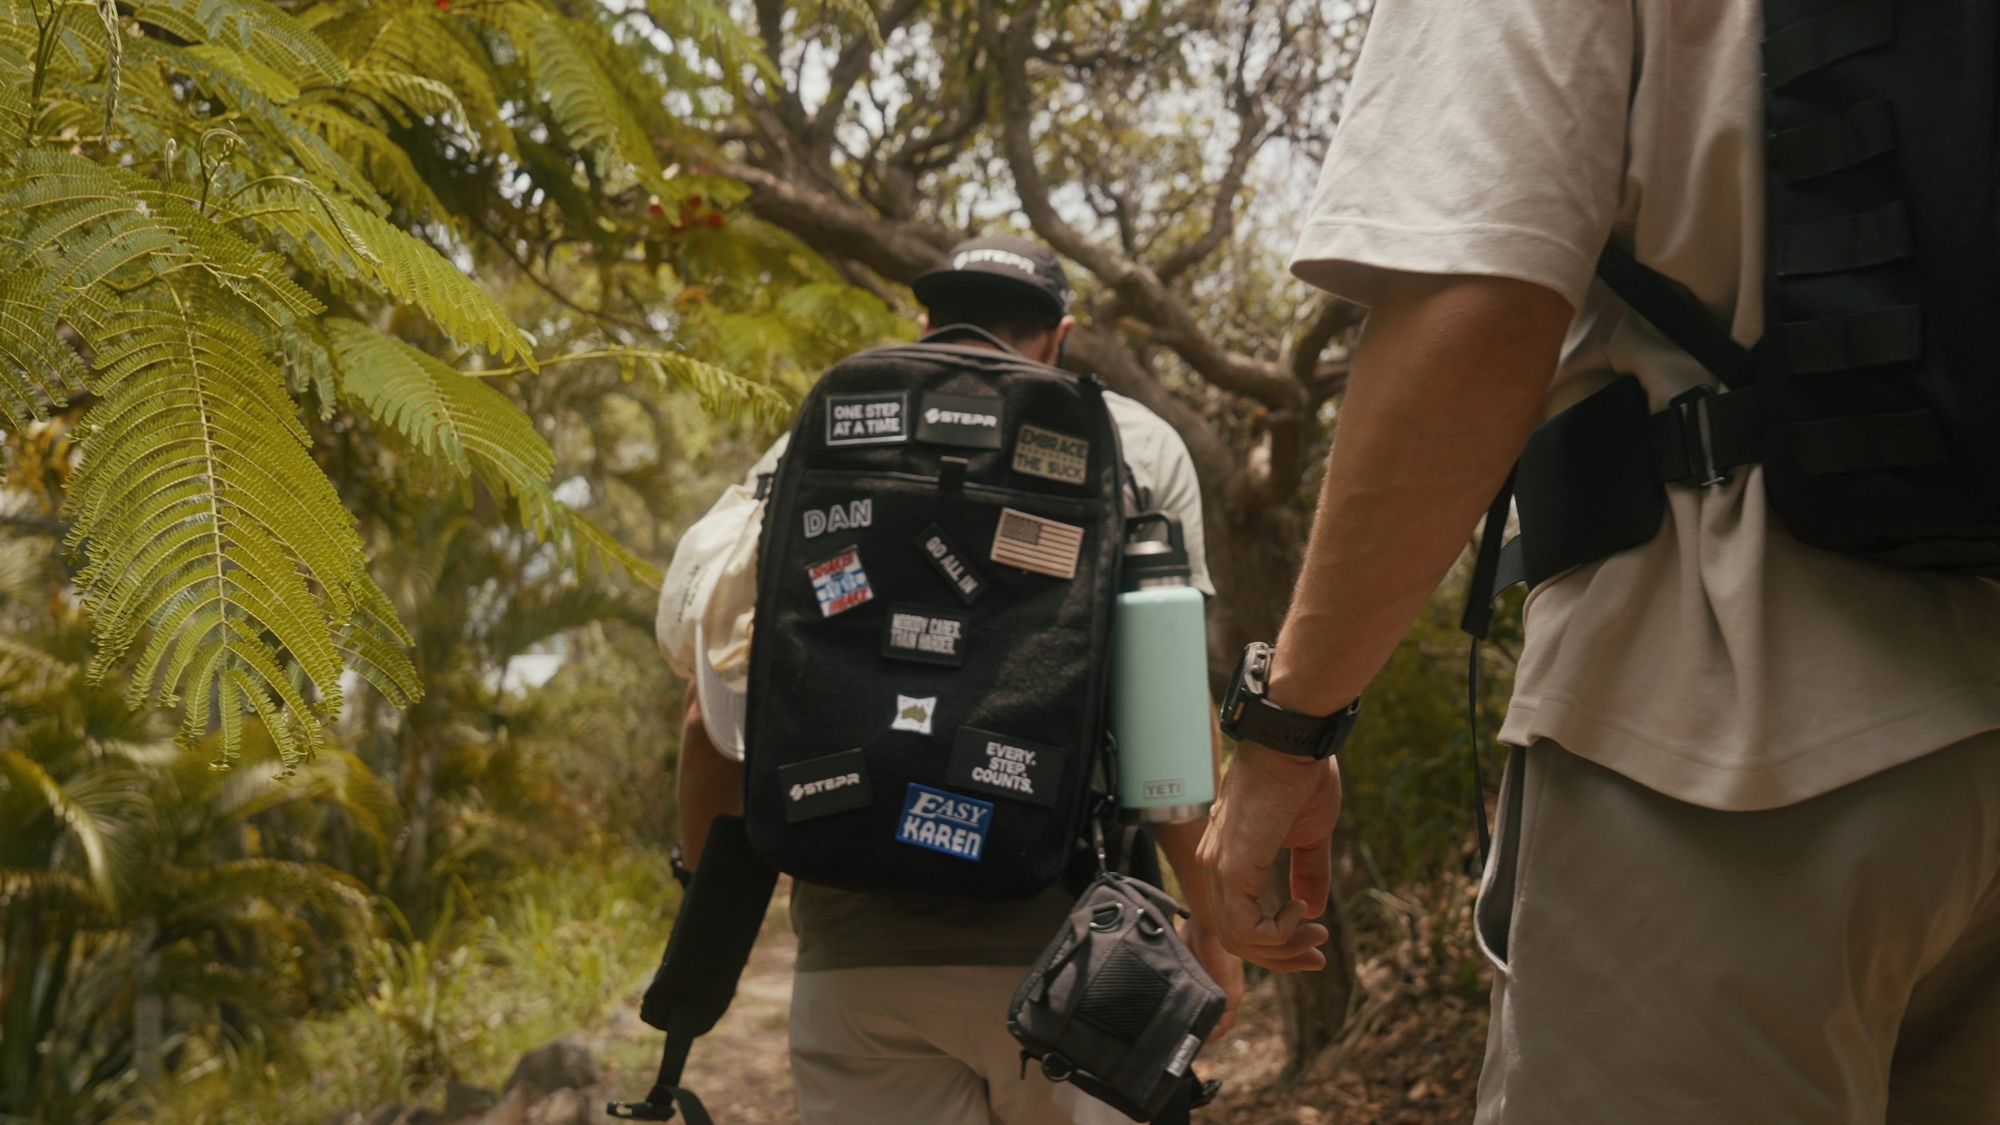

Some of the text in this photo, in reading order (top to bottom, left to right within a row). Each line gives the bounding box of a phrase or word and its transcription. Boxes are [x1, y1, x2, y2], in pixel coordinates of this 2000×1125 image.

[834, 403, 901, 420] ONE STEP
[940, 411, 998, 428] STEPR
[833, 418, 900, 436] AT A TIME
[1022, 429, 1088, 458] EMBRACE
[1018, 453, 1085, 480] THE SUCK
[803, 498, 872, 539] DAN
[925, 536, 978, 594] GO ALL IN
[985, 742, 1036, 766] EVERY.
[988, 756, 1028, 777] STEP.
[802, 772, 861, 796] STEPR
[972, 766, 1034, 794] COUNTS.
[1147, 783, 1181, 796] YETI
[909, 791, 989, 827] EASY
[903, 816, 982, 857] KAREN
